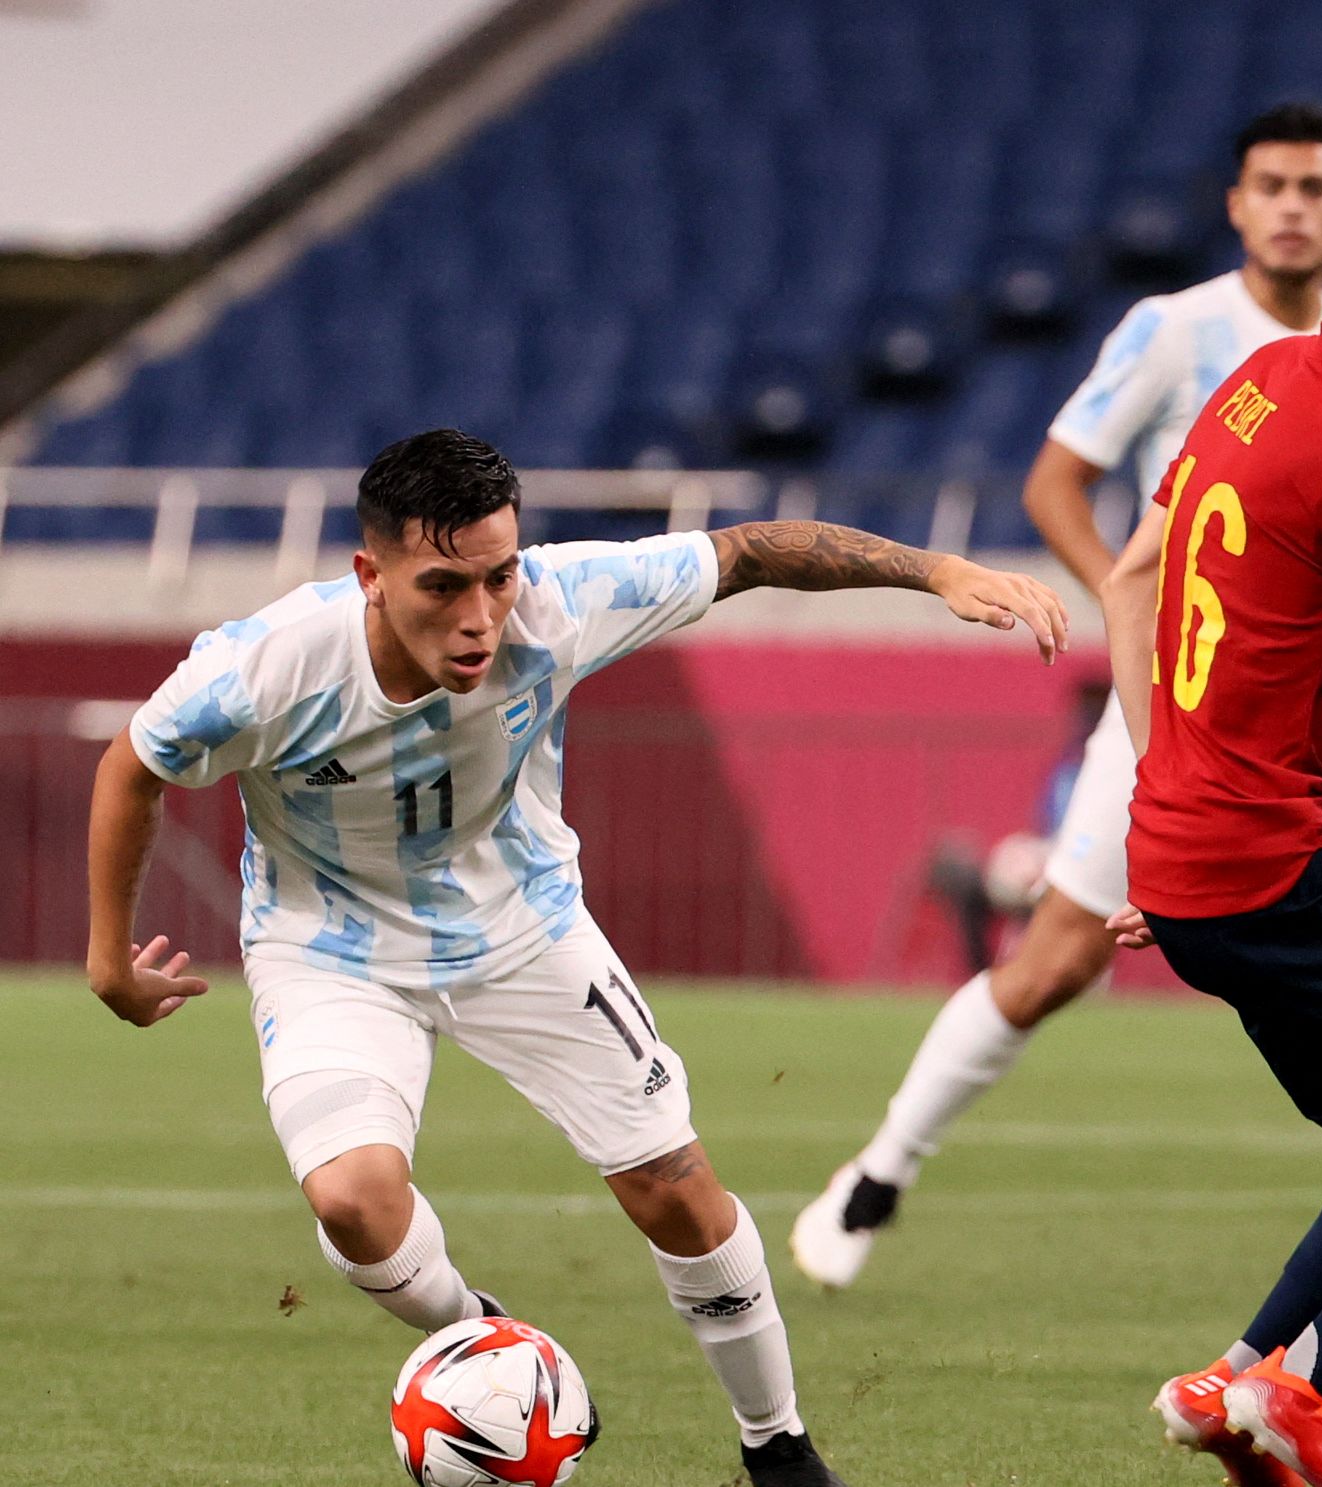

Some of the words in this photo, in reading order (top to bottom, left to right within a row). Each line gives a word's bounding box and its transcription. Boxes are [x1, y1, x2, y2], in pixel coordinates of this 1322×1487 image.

[1215, 379, 1278, 446] PEDRI
[393, 769, 453, 837] 11
[583, 965, 658, 1063] 11
[692, 1292, 761, 1317] adidas
